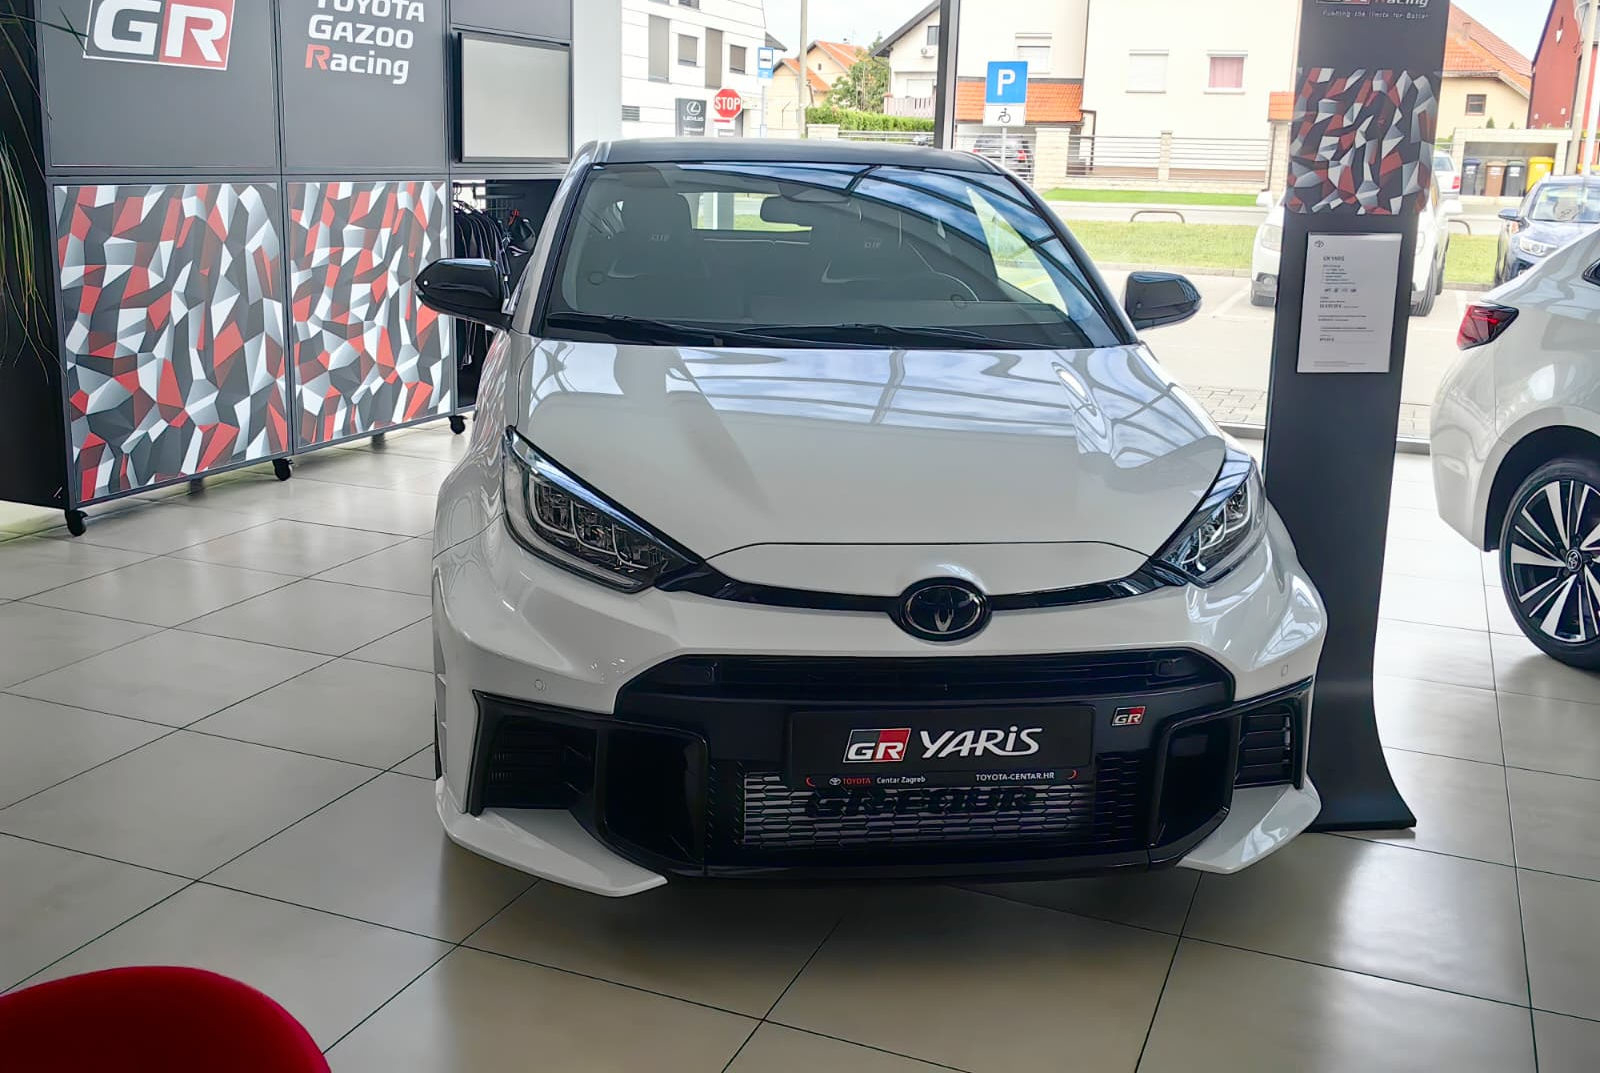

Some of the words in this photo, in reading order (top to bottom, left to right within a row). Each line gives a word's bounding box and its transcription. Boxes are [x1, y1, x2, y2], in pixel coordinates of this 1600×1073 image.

[93, 0, 227, 62] GR
[308, 14, 414, 49] GAZOO
[304, 43, 409, 85] Racing
[996, 68, 1017, 96] P
[714, 96, 741, 111] STOP
[1114, 713, 1142, 724] GR
[847, 741, 904, 761] GR
[842, 777, 871, 785] TOYOTA
[876, 776, 900, 785] Centar
[900, 776, 926, 785] Zagreb
[975, 771, 1056, 782] TOYOTA-CENTAR.HR
